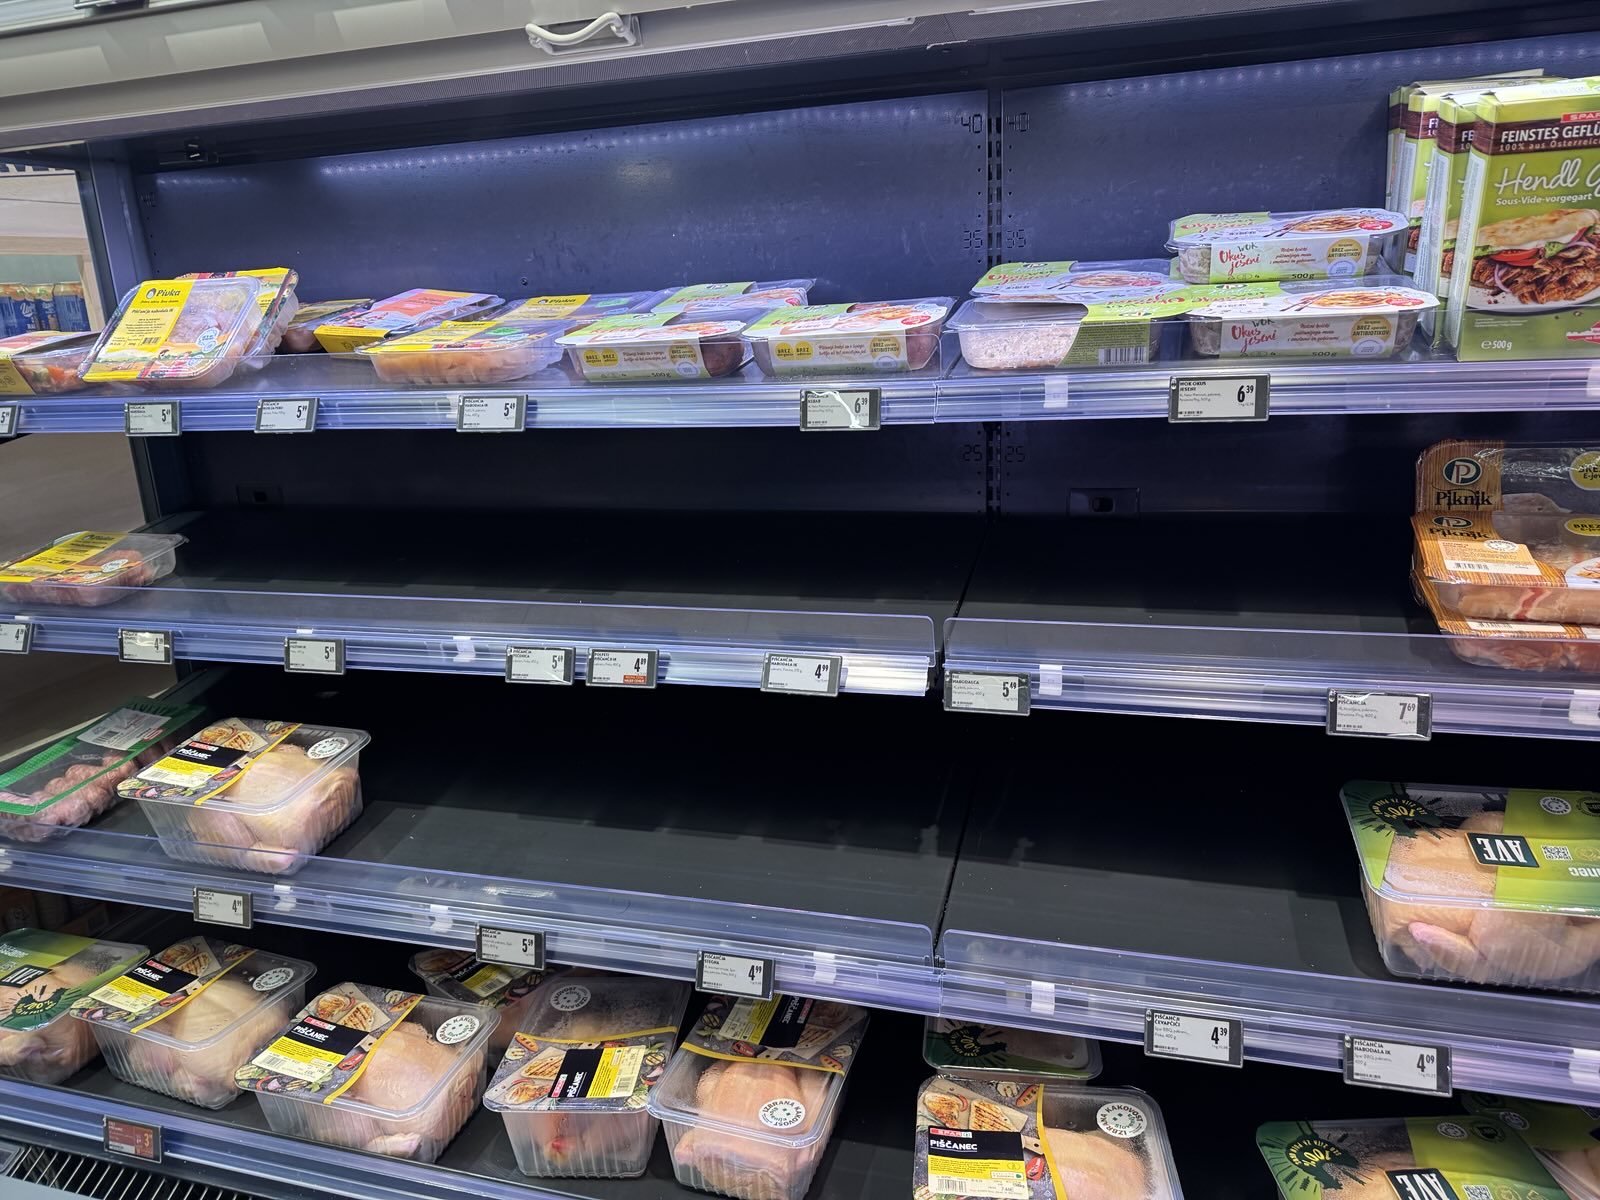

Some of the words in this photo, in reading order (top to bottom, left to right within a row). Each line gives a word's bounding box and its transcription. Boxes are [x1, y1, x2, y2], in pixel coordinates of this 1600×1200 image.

[961, 113, 983, 134] 40
[1501, 127, 1559, 143] FEINSTES
[1499, 142, 1525, 151] 100%
[1494, 158, 1582, 195] Hendl
[1496, 193, 1593, 206] Sous-Vide-vorgegart
[963, 229, 983, 250] 35
[1007, 229, 1026, 249] 35
[1219, 250, 1246, 264] Okus
[1227, 254, 1261, 277] jeseni
[156, 289, 181, 297] Pivka
[1231, 325, 1261, 340] Okus
[1240, 329, 1277, 353] jeseni
[1434, 489, 1494, 511] Piknik
[1429, 528, 1490, 540] Piknik
[1476, 837, 1528, 864] AVE
[2, 967, 46, 985] AVE
[135, 967, 164, 981] PIŠČANEC
[294, 1025, 329, 1041] PIŠČANEC
[763, 1100, 795, 1113] IZBRANA
[1105, 1104, 1143, 1122] KAKOVOST
[774, 1105, 802, 1127] KAKOVOST
[1100, 1113, 1127, 1136] IZBRANA
[930, 1138, 978, 1150] PIŠČANEC
[1395, 1173, 1450, 1200] AVE
